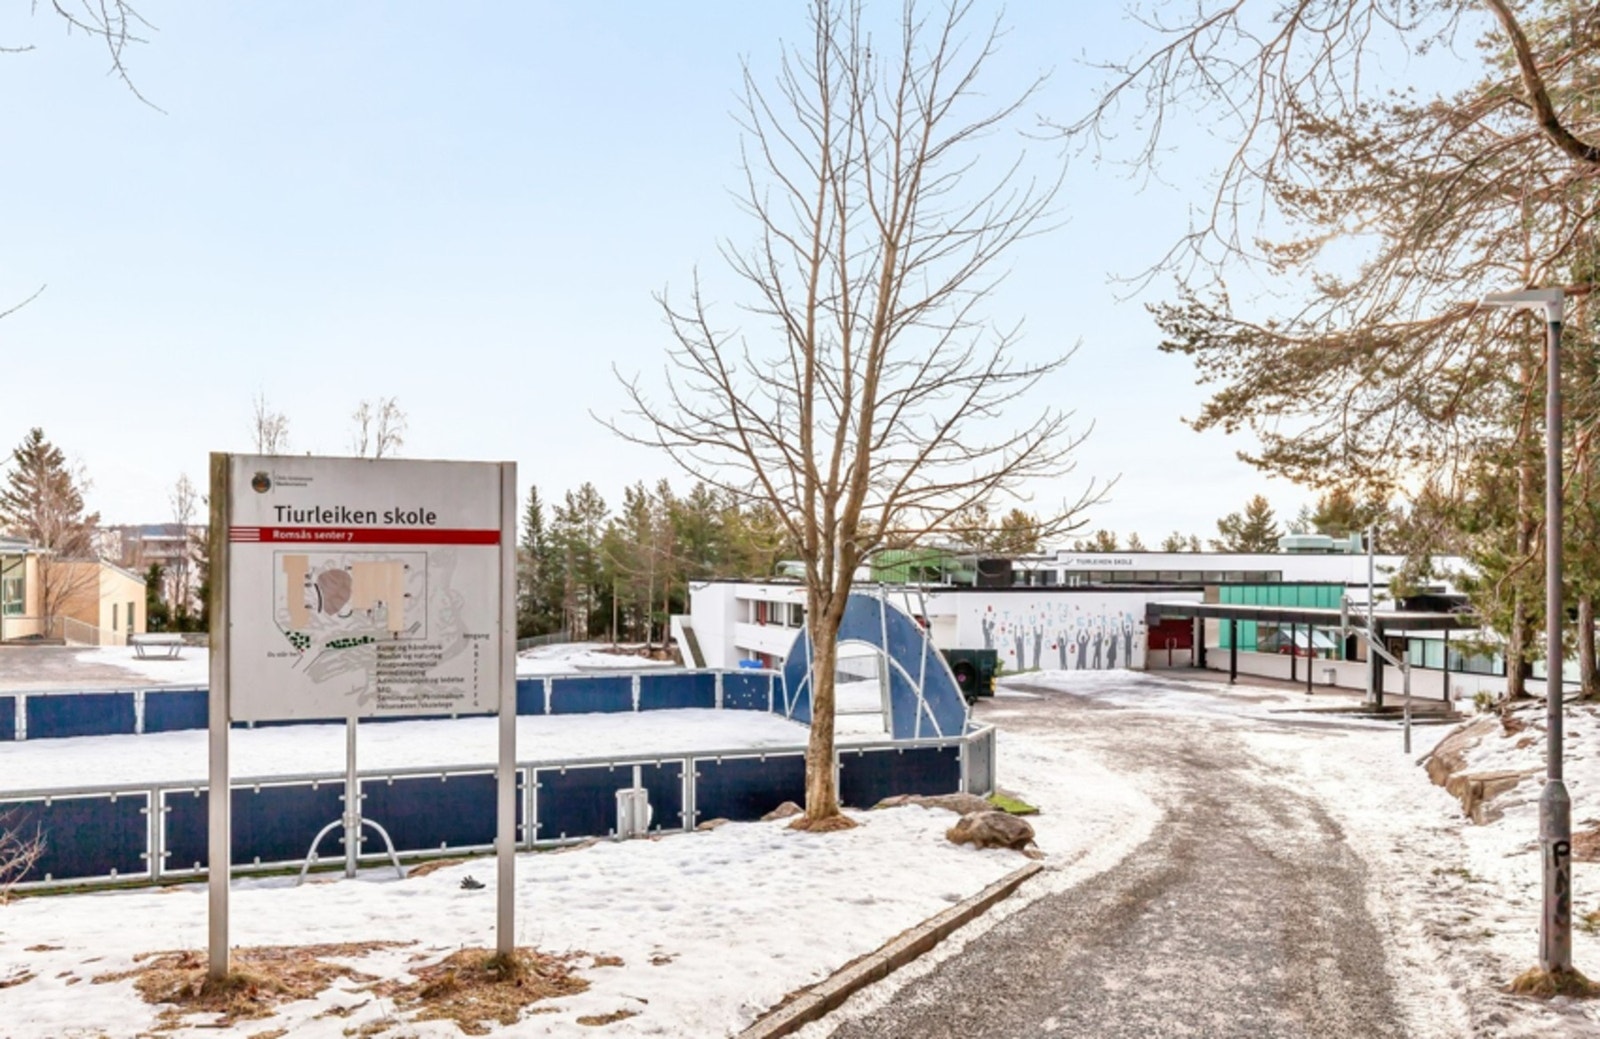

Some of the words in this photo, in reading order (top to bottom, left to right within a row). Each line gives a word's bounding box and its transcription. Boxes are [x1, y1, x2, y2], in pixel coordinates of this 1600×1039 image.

[274, 505, 377, 525] Tiurleiken
[384, 507, 437, 525] skole
[273, 530, 312, 540] Romsås
[314, 532, 345, 541] senter
[346, 533, 353, 542] 7
